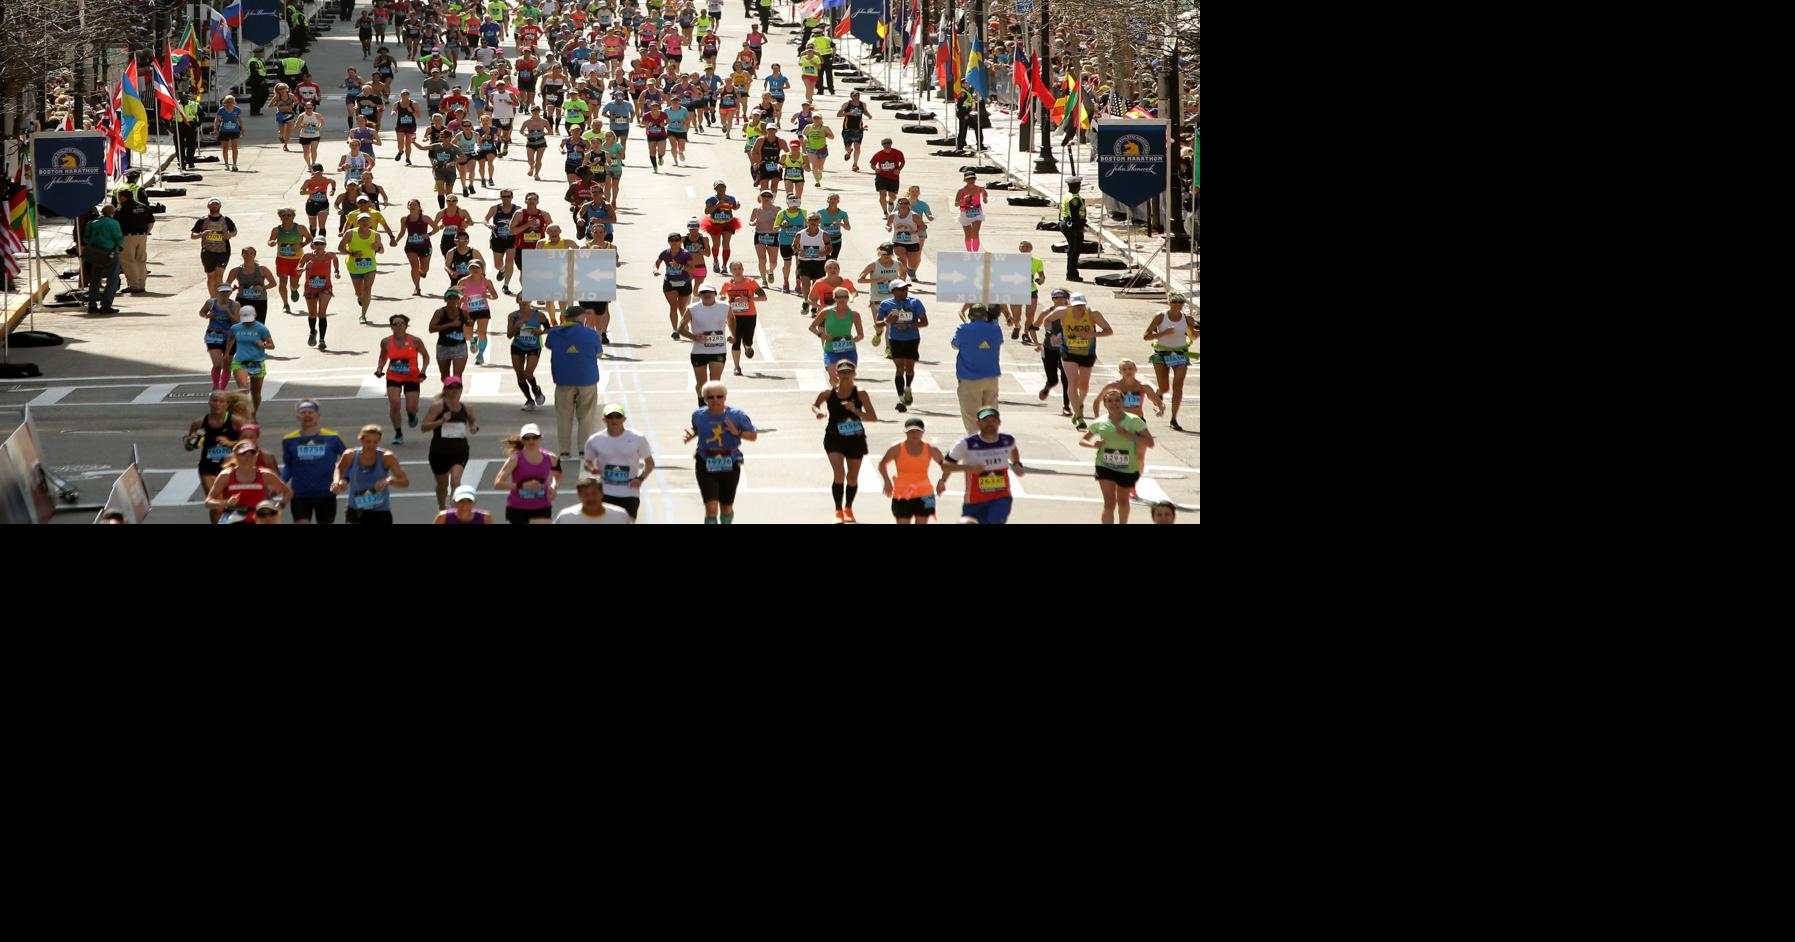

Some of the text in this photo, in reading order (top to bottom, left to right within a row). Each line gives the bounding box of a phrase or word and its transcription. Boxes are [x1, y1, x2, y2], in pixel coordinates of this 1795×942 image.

[851, 8, 868, 18] John
[1105, 163, 1157, 177] John Hancock
[44, 175, 93, 190] John Hancock
